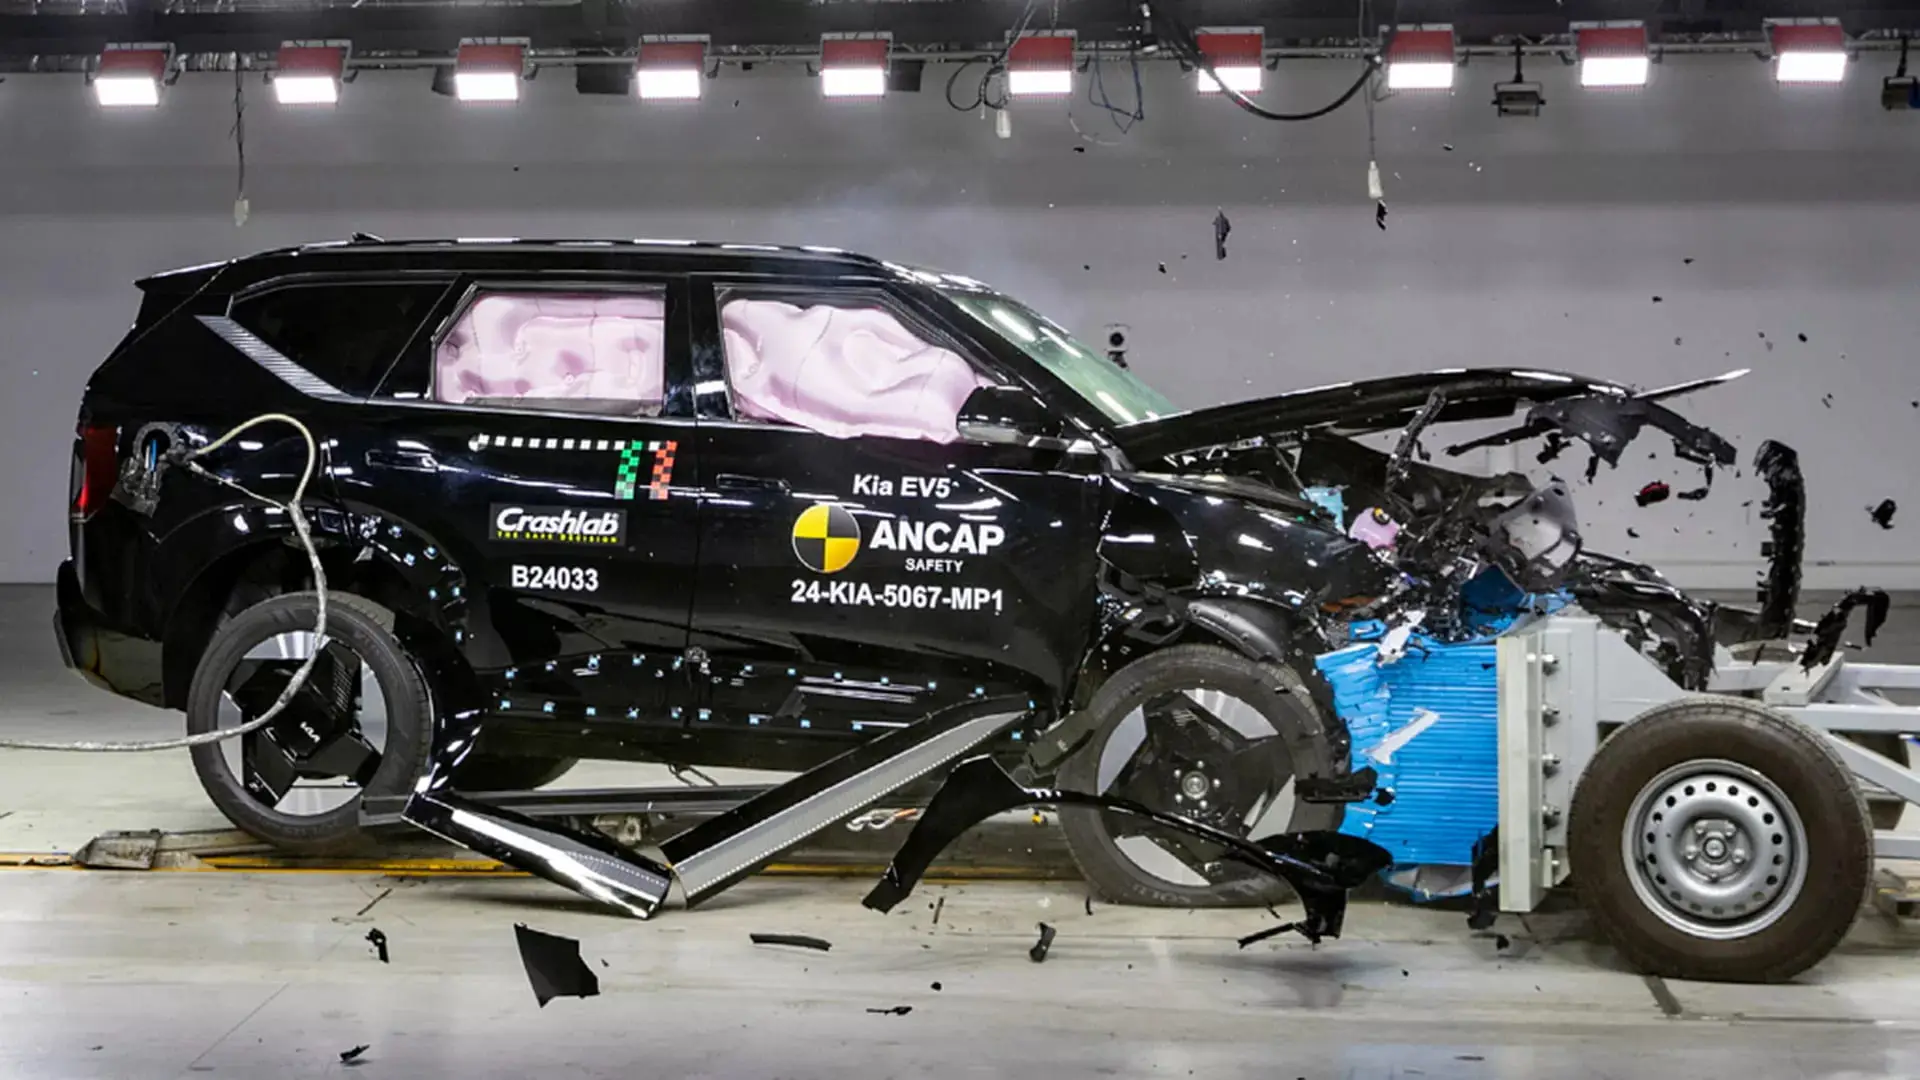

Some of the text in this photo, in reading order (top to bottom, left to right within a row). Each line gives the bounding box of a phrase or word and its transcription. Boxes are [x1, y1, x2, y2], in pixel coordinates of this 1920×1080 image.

[852, 474, 951, 498] Kia EV5
[496, 507, 620, 535] Crashlab
[869, 520, 1006, 555] ANCAP
[511, 564, 599, 592] B24033
[905, 558, 964, 574] SAFETY
[791, 579, 1003, 611] 24-KIA-5067-MP1
